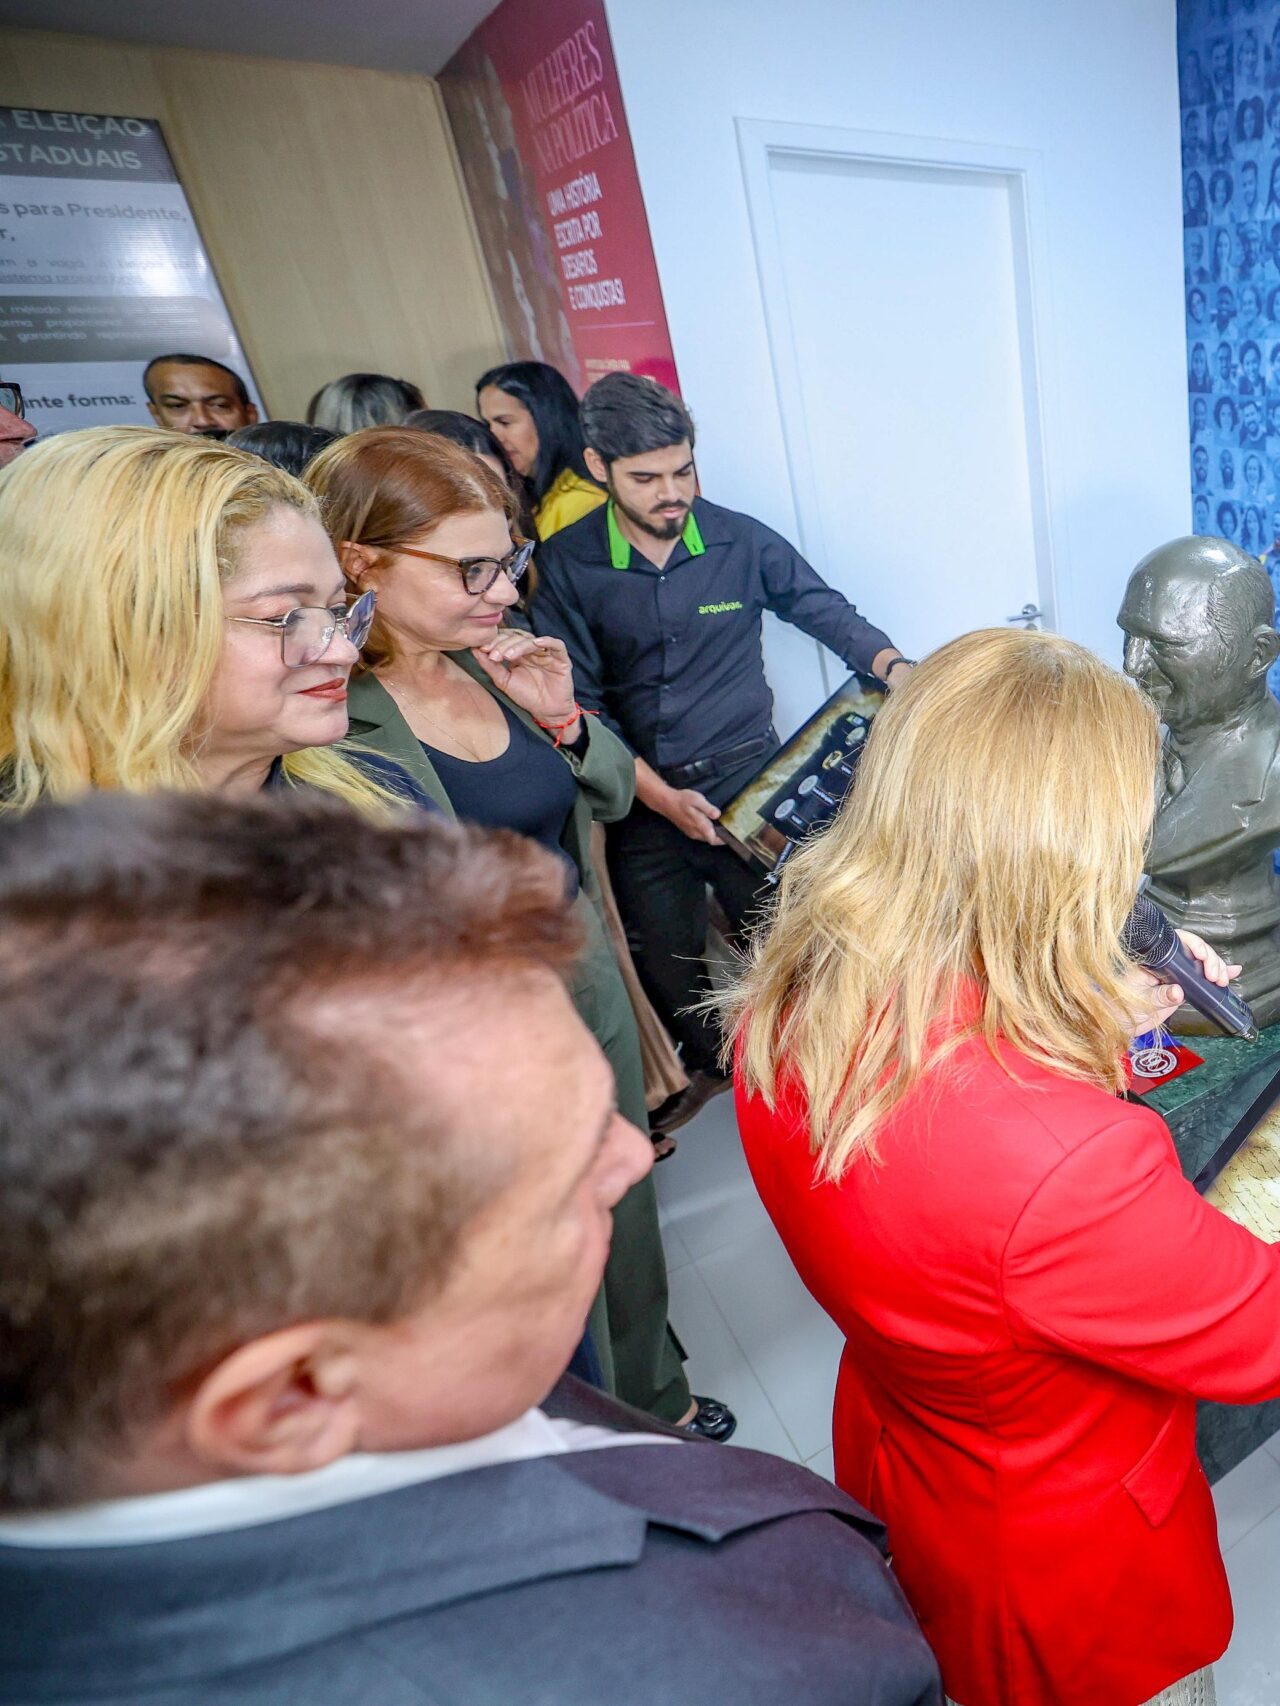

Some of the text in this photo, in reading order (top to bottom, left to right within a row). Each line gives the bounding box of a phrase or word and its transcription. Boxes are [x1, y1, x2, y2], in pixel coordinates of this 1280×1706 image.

[519, 20, 604, 129] MULHERES
[562, 170, 603, 211] HISTÓRIA
[13, 203, 65, 218] para
[67, 203, 187, 222] Presidente,
[553, 210, 603, 249] ESCRITA POR
[560, 248, 598, 280] DESAFIOS
[67, 393, 136, 408] forma:
